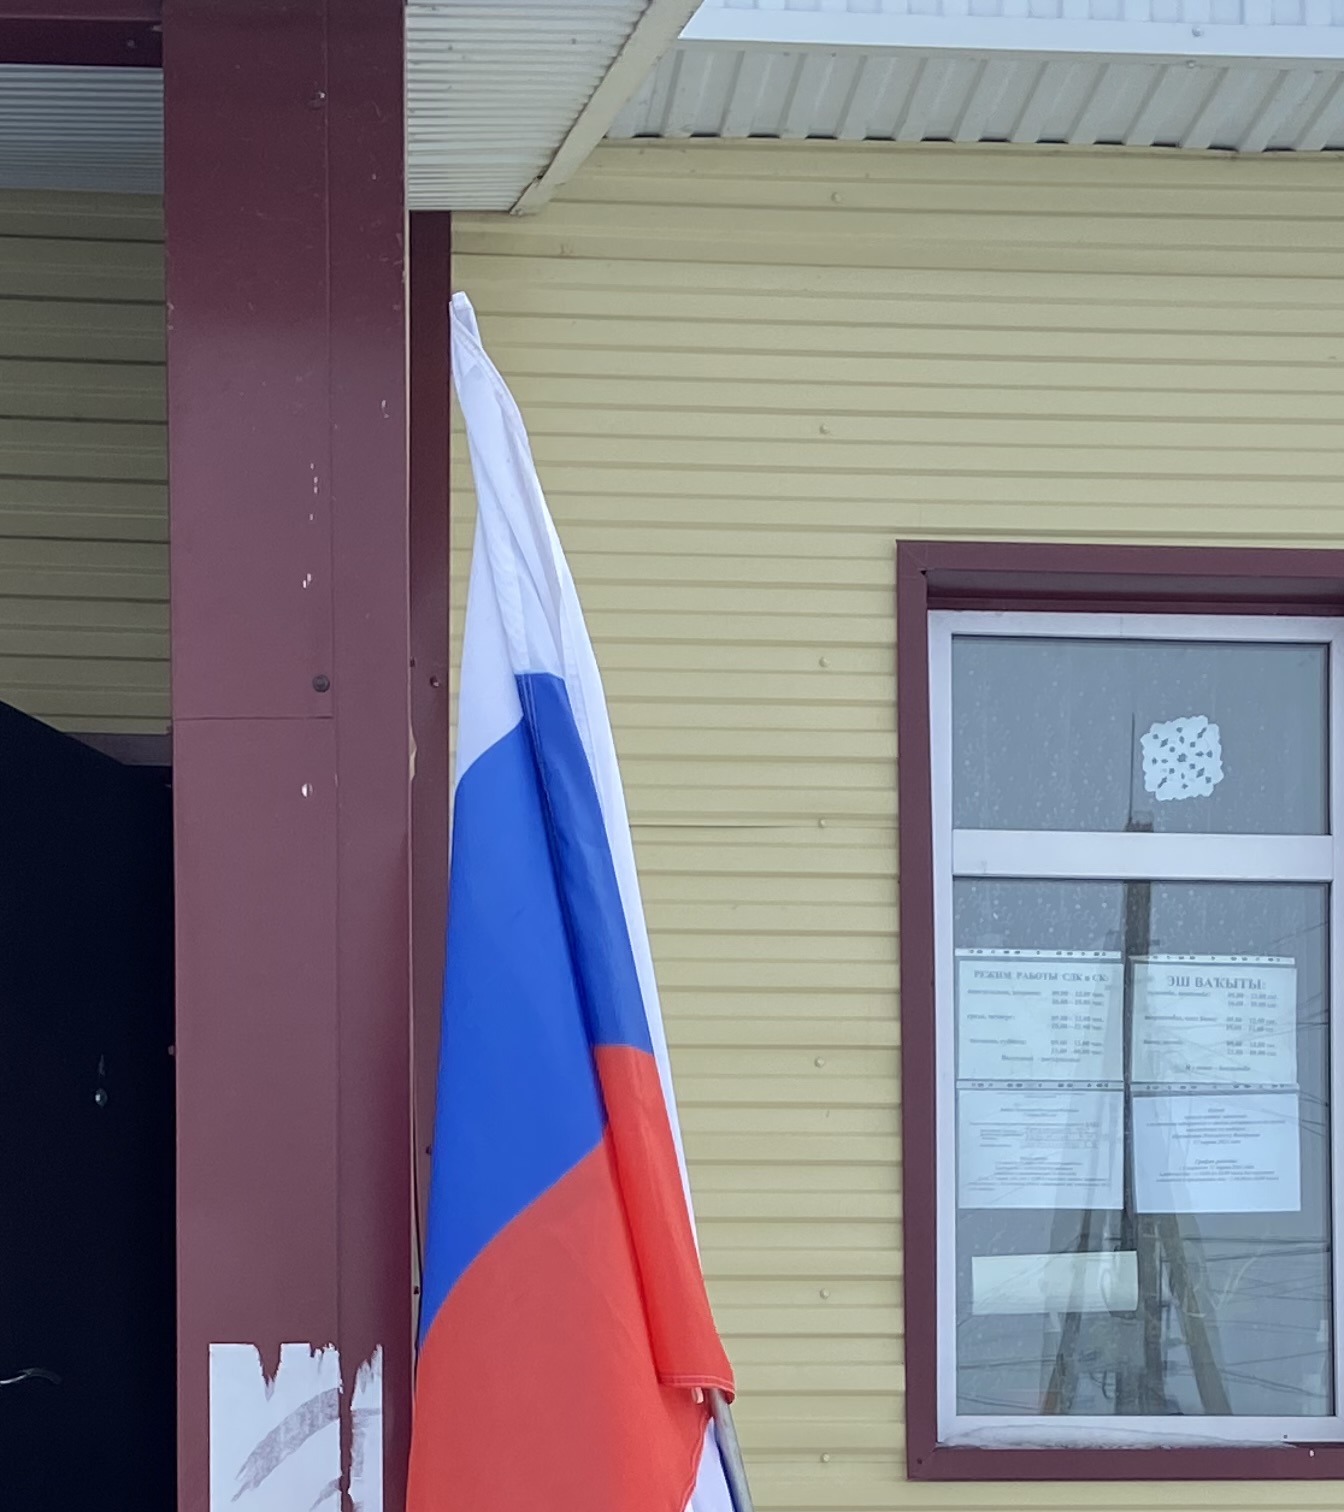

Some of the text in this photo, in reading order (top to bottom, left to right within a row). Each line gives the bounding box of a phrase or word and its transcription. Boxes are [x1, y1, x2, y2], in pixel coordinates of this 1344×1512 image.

[973, 969, 1013, 979] РЕЖИМ
[1016, 971, 1059, 981] РАБОТЫ
[1167, 975, 1191, 988] ЭШ
